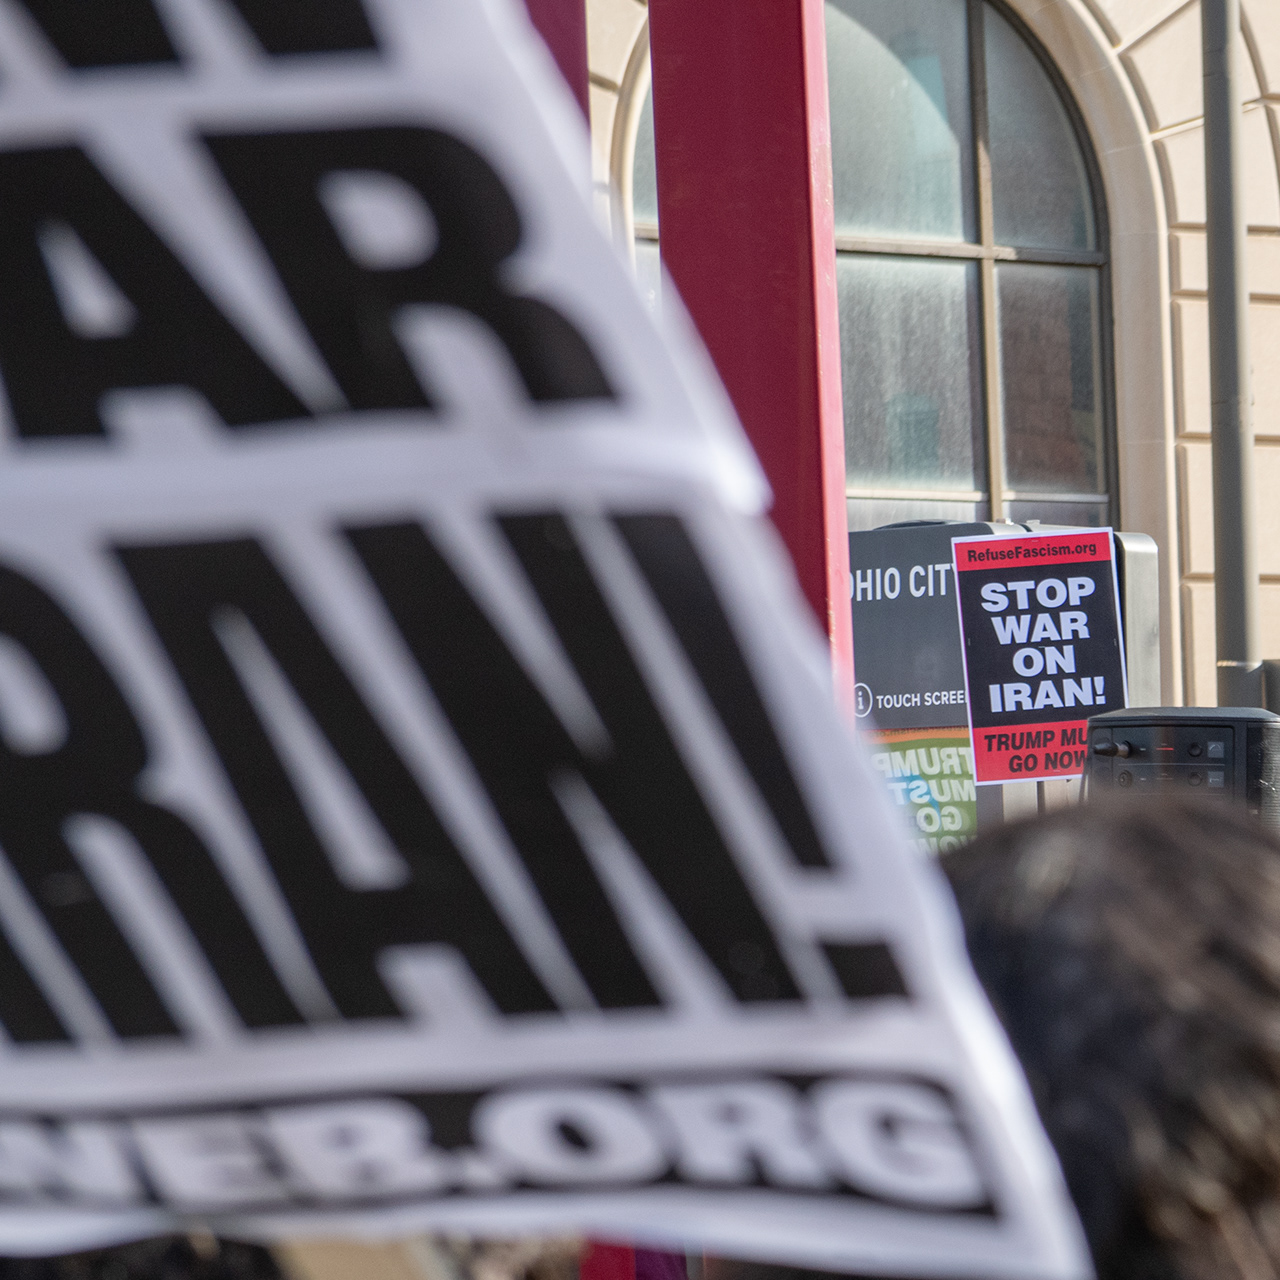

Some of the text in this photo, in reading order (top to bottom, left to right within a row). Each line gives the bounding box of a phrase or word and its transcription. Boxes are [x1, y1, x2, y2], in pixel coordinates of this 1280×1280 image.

[0, 126, 620, 437] AR
[967, 543, 1097, 563] RefuseFascism.org
[849, 563, 956, 602] HIO CIT
[980, 577, 1096, 612] STOP
[991, 611, 1090, 645] WAR
[1012, 645, 1076, 677] ON
[876, 690, 969, 709] TOUCH SCREE
[989, 676, 1106, 713] IRAN!
[984, 730, 1055, 752] TRUMP
[1061, 728, 1089, 747] MU
[0, 500, 918, 1050] RAN!
[1009, 750, 1088, 773] GO NOW
